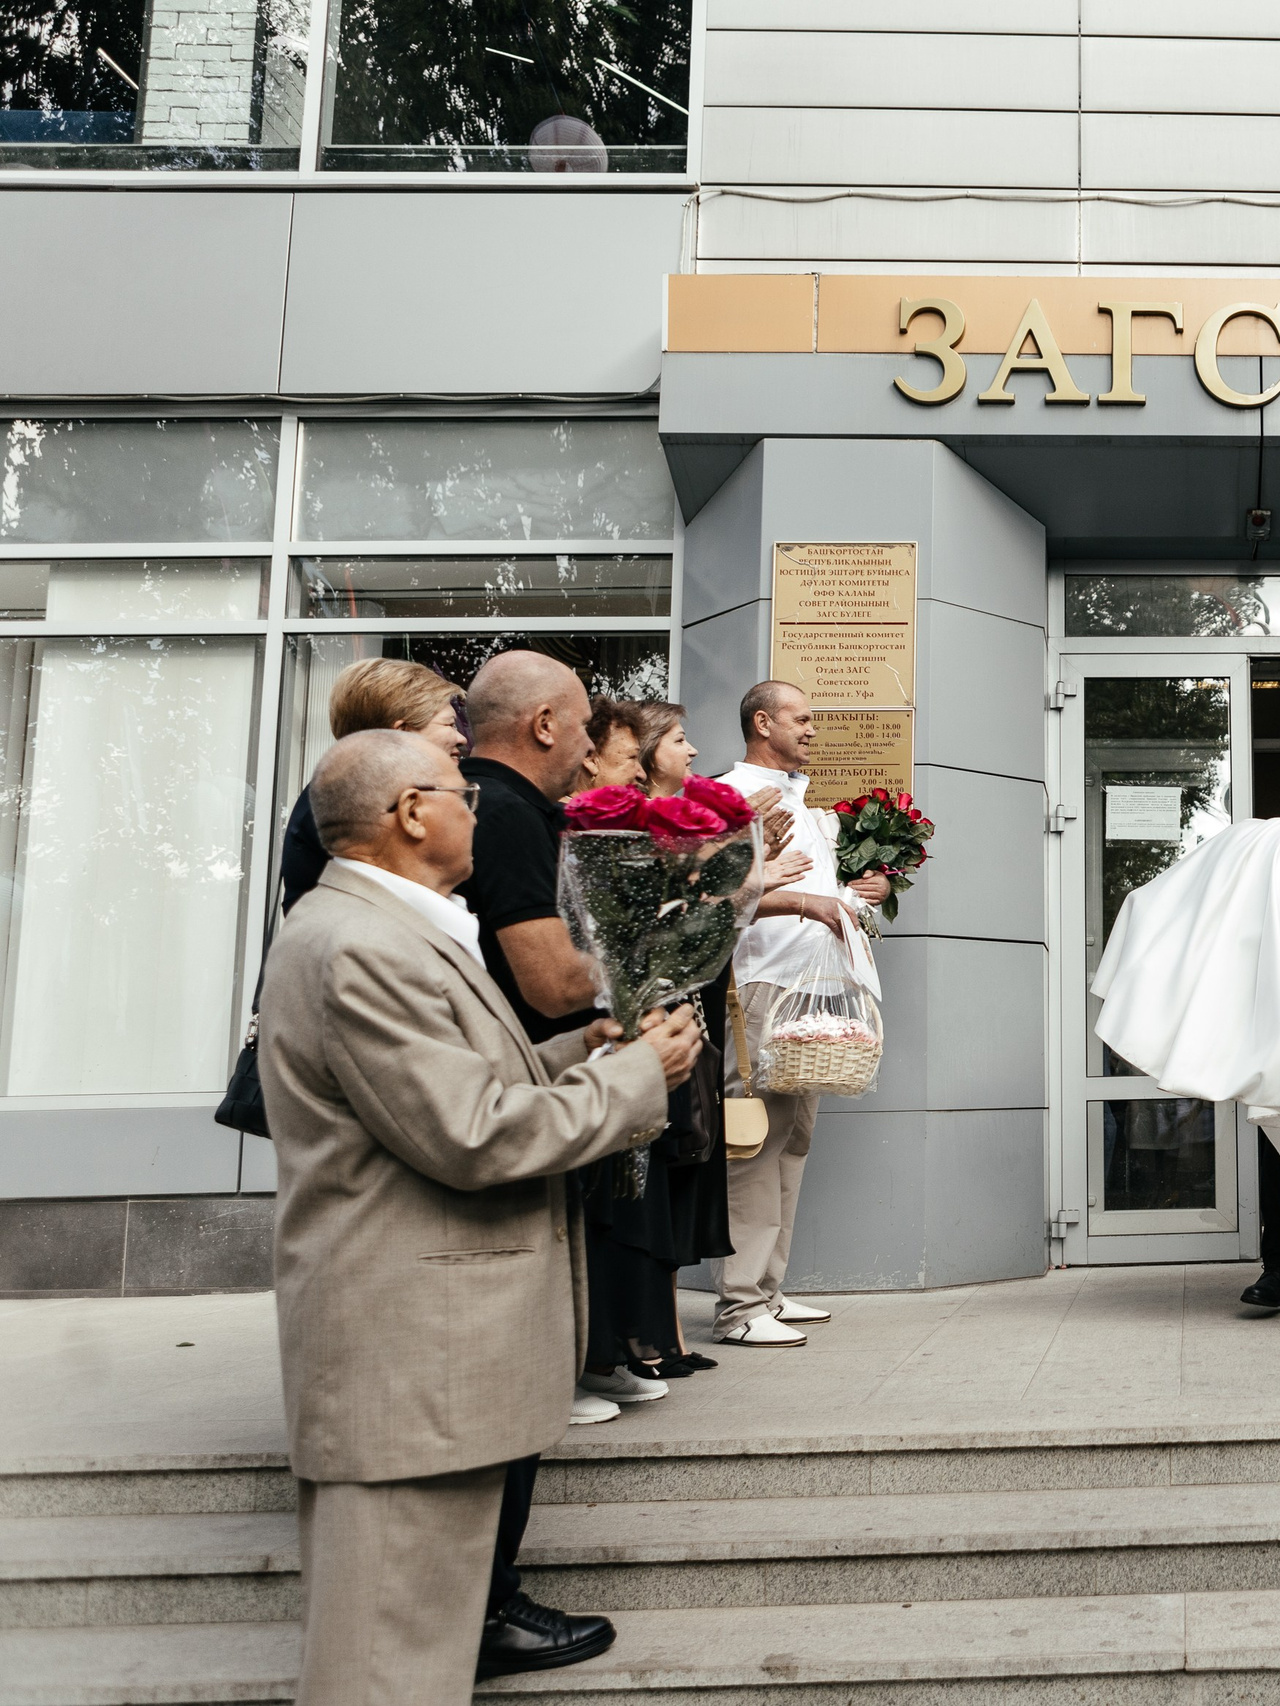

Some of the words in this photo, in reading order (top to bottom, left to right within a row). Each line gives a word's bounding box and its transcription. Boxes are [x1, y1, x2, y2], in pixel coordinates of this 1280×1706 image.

[867, 568, 910, 576] БУЙЫНСА
[839, 579, 890, 587] КОМИТЕТЫ
[798, 600, 828, 608] СОВЕТ
[782, 631, 864, 640] Государственный
[781, 642, 836, 652] Республики
[838, 643, 906, 652] Башкортостан
[815, 666, 844, 674] Отдел
[846, 666, 871, 674] ЗАГС
[811, 690, 845, 699] района
[855, 690, 874, 699] Уфа
[840, 768, 888, 777] РАБОТЫ:
[820, 779, 848, 787] суббота
[884, 778, 904, 786] 18.00
